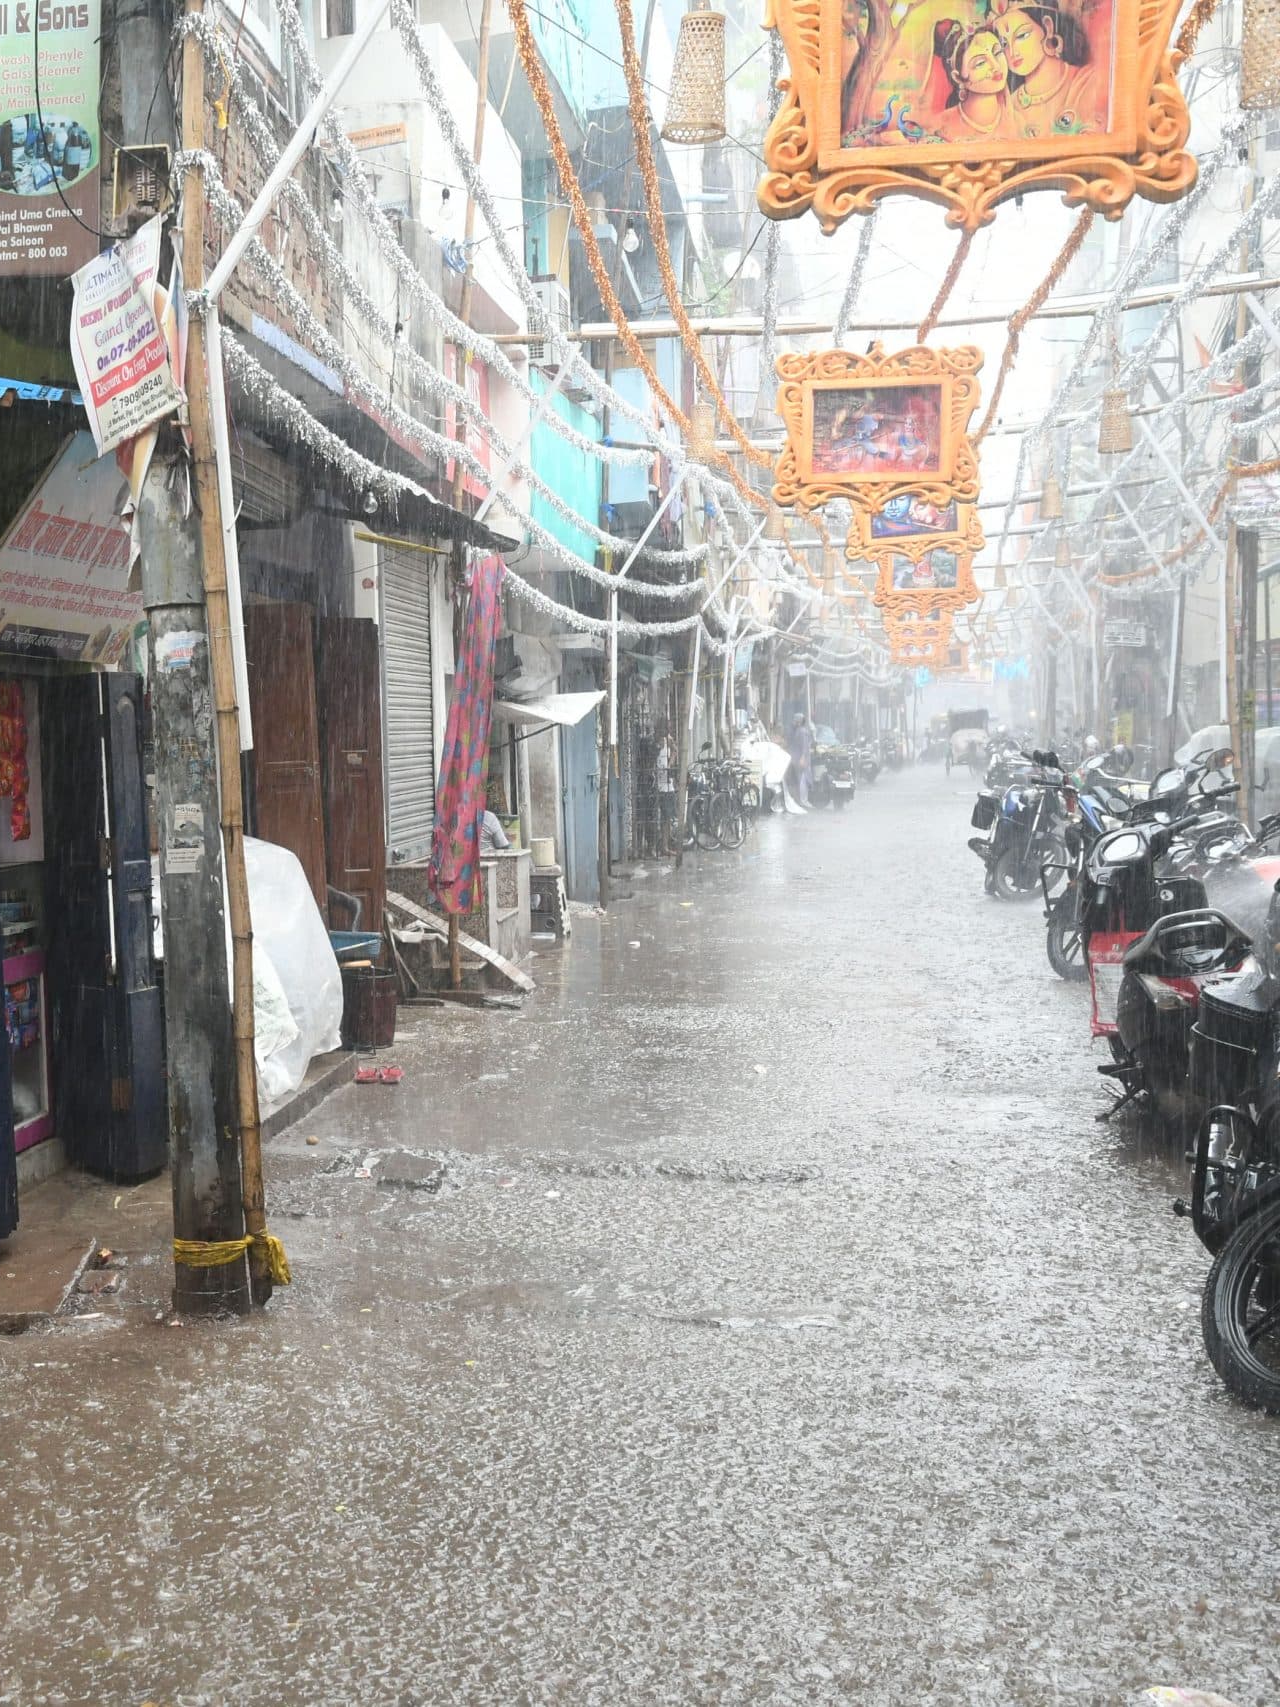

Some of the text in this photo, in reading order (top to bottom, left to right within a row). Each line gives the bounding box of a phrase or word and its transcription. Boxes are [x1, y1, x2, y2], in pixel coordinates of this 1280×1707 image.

[16, 2, 31, 33] &
[39, 0, 89, 31] Sons
[38, 48, 84, 61] Phenyle
[8, 93, 86, 110] Mainenance)
[20, 210, 42, 220] Uma
[14, 222, 53, 233] Bhawan
[10, 237, 44, 246] Saloon
[28, 247, 46, 258] 800
[50, 246, 68, 257] 003
[122, 363, 134, 381] On
